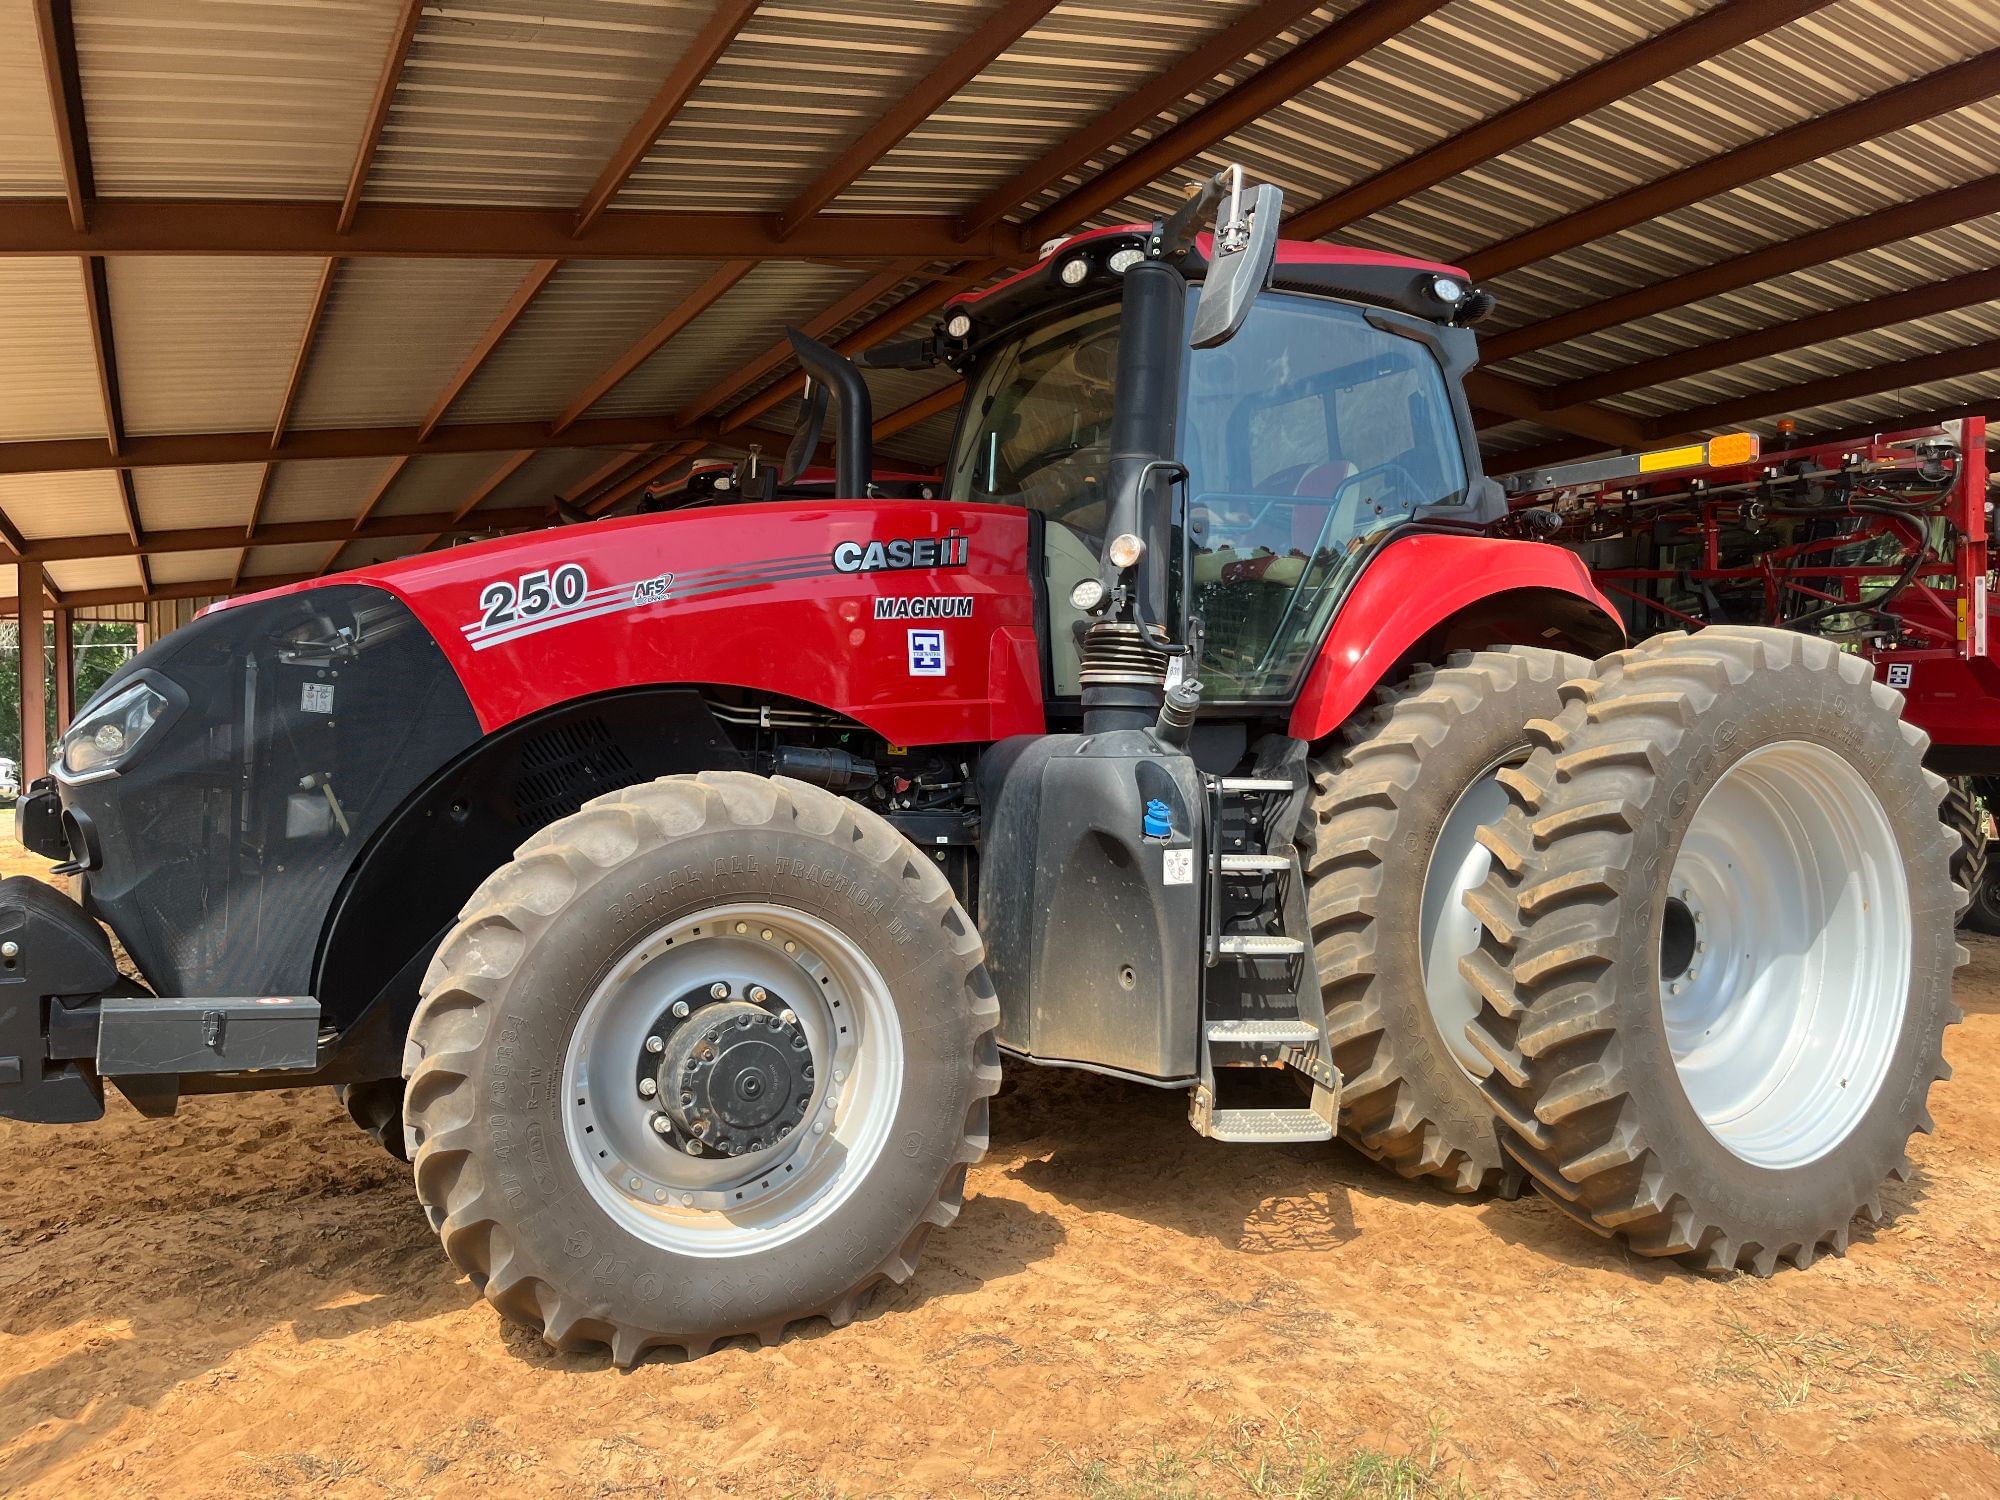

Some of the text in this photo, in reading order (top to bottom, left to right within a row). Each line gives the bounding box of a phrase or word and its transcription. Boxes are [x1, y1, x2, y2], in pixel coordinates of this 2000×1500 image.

[479, 563, 588, 631] 250
[633, 577, 668, 599] AFS
[874, 596, 973, 620] MAGNUM
[606, 854, 914, 945] RADIAL ALL TRACTION DT
[526, 1066, 542, 1110] R-1W
